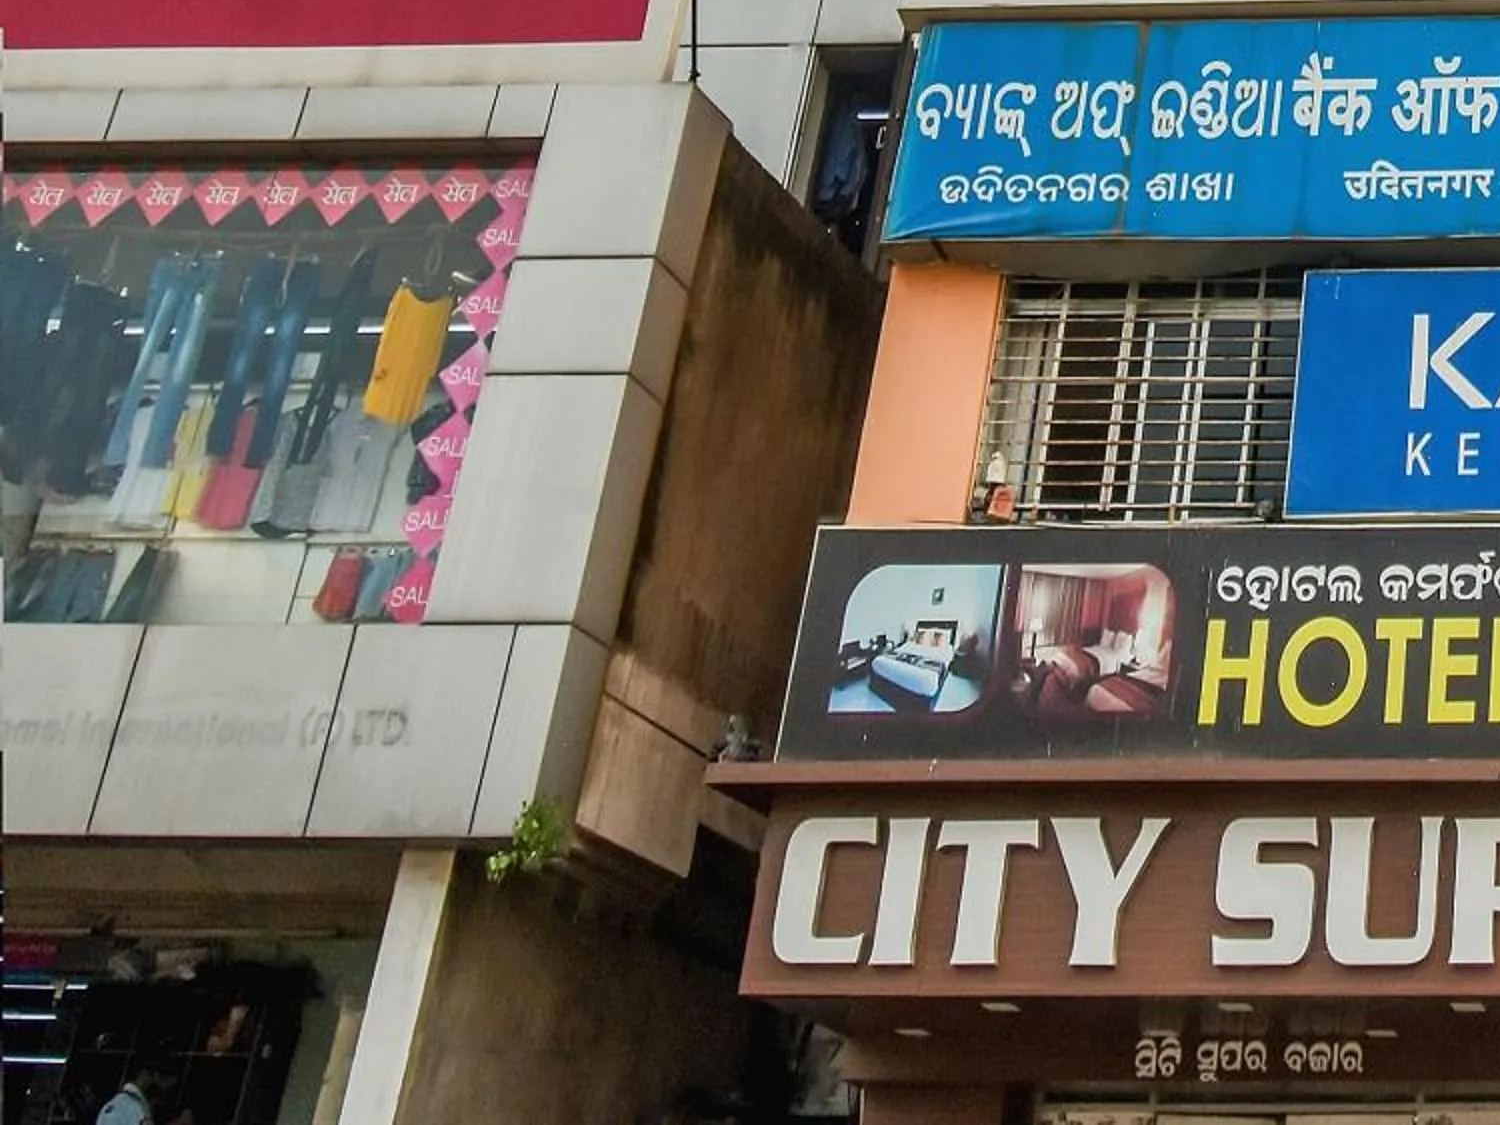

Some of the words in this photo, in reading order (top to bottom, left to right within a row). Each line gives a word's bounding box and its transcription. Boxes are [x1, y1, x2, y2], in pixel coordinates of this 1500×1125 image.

[1291, 51, 1378, 136] बैंक
[1343, 159, 1495, 200] उदितनगर
[770, 816, 1172, 967] CITY
